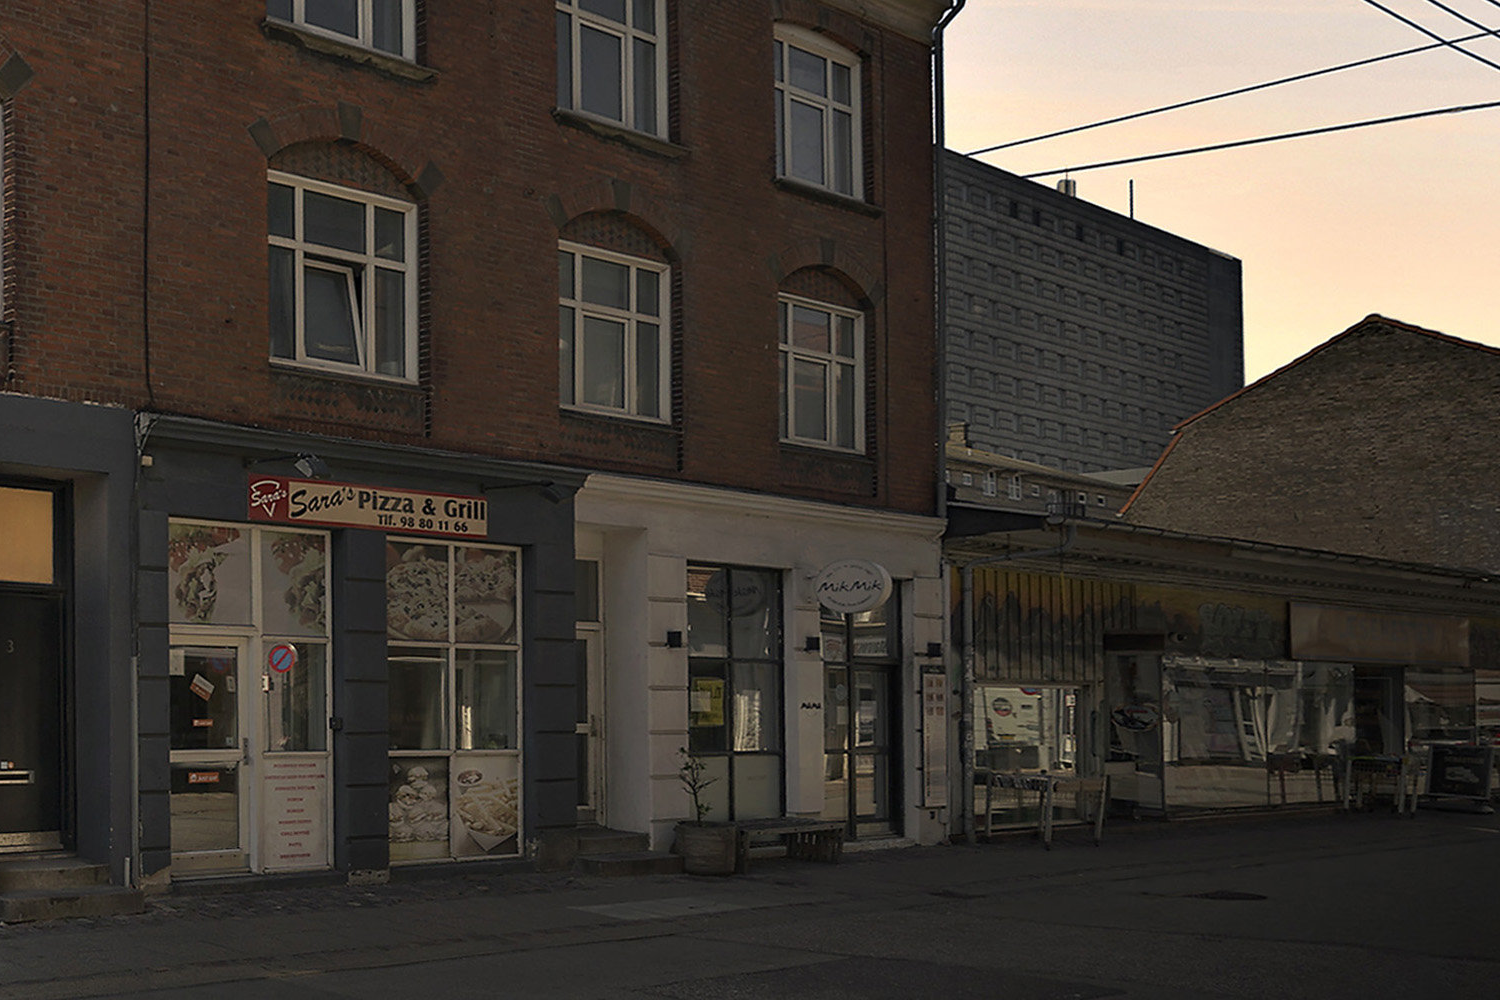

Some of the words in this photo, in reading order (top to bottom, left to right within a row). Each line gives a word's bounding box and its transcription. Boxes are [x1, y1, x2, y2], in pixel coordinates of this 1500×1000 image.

[290, 487, 355, 517] Sara's
[358, 490, 414, 516] Pizza
[422, 498, 436, 515] &
[444, 499, 485, 520] Grill
[400, 516, 414, 528] 98
[419, 518, 433, 530] 80
[439, 520, 450, 531] 11
[454, 521, 469, 533] 66
